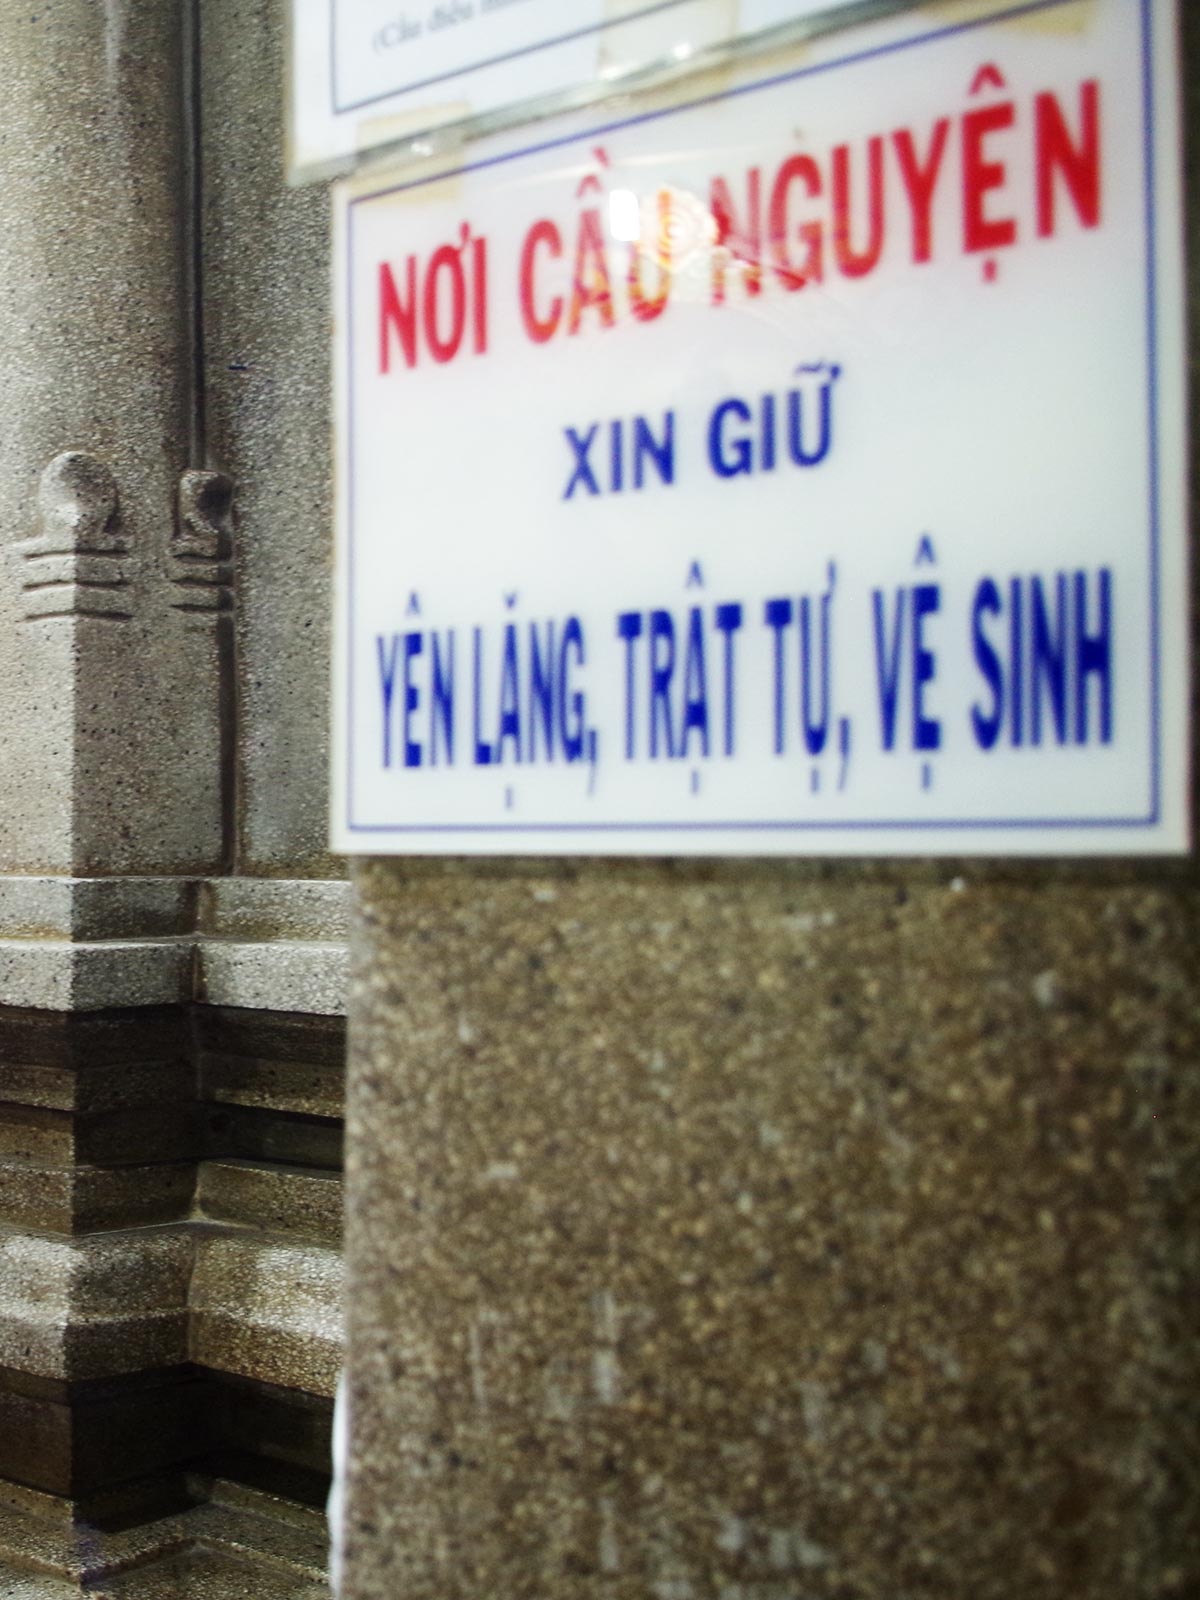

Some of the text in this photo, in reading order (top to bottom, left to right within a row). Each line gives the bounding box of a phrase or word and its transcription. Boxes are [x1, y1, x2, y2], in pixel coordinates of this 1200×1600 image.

[378, 63, 1101, 375] NƠI CẦU NGUYỆN
[562, 359, 842, 502] XIN GIỮ
[375, 533, 1113, 809] YÊN LẶNG, TRẬT TỰ, VỆ SINH
